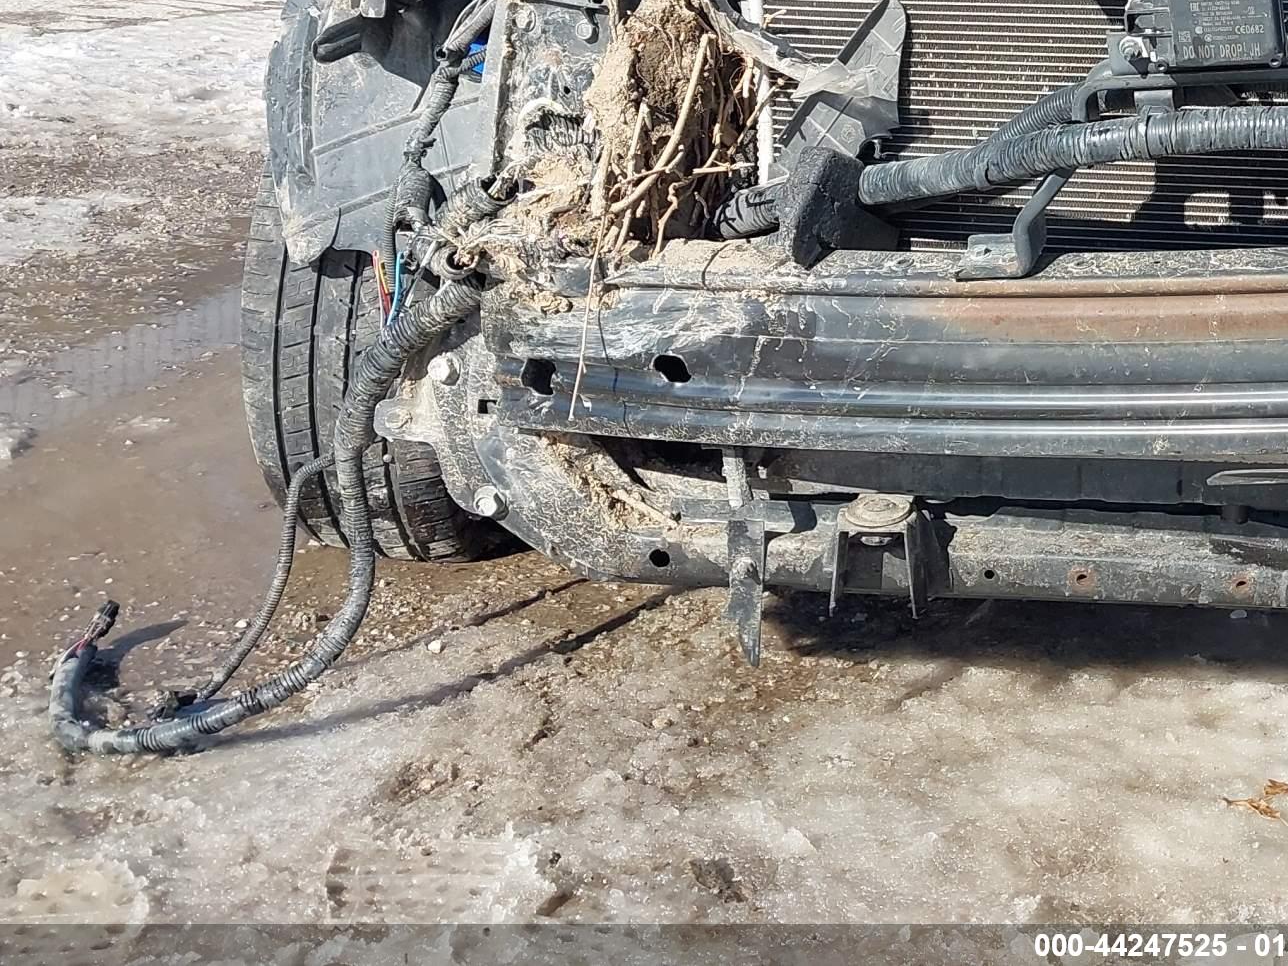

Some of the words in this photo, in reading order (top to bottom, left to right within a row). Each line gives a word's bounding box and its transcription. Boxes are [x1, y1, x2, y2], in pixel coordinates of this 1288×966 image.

[1182, 45, 1195, 60] DO
[1198, 44, 1216, 59] NOT
[1219, 41, 1247, 59] DROP!
